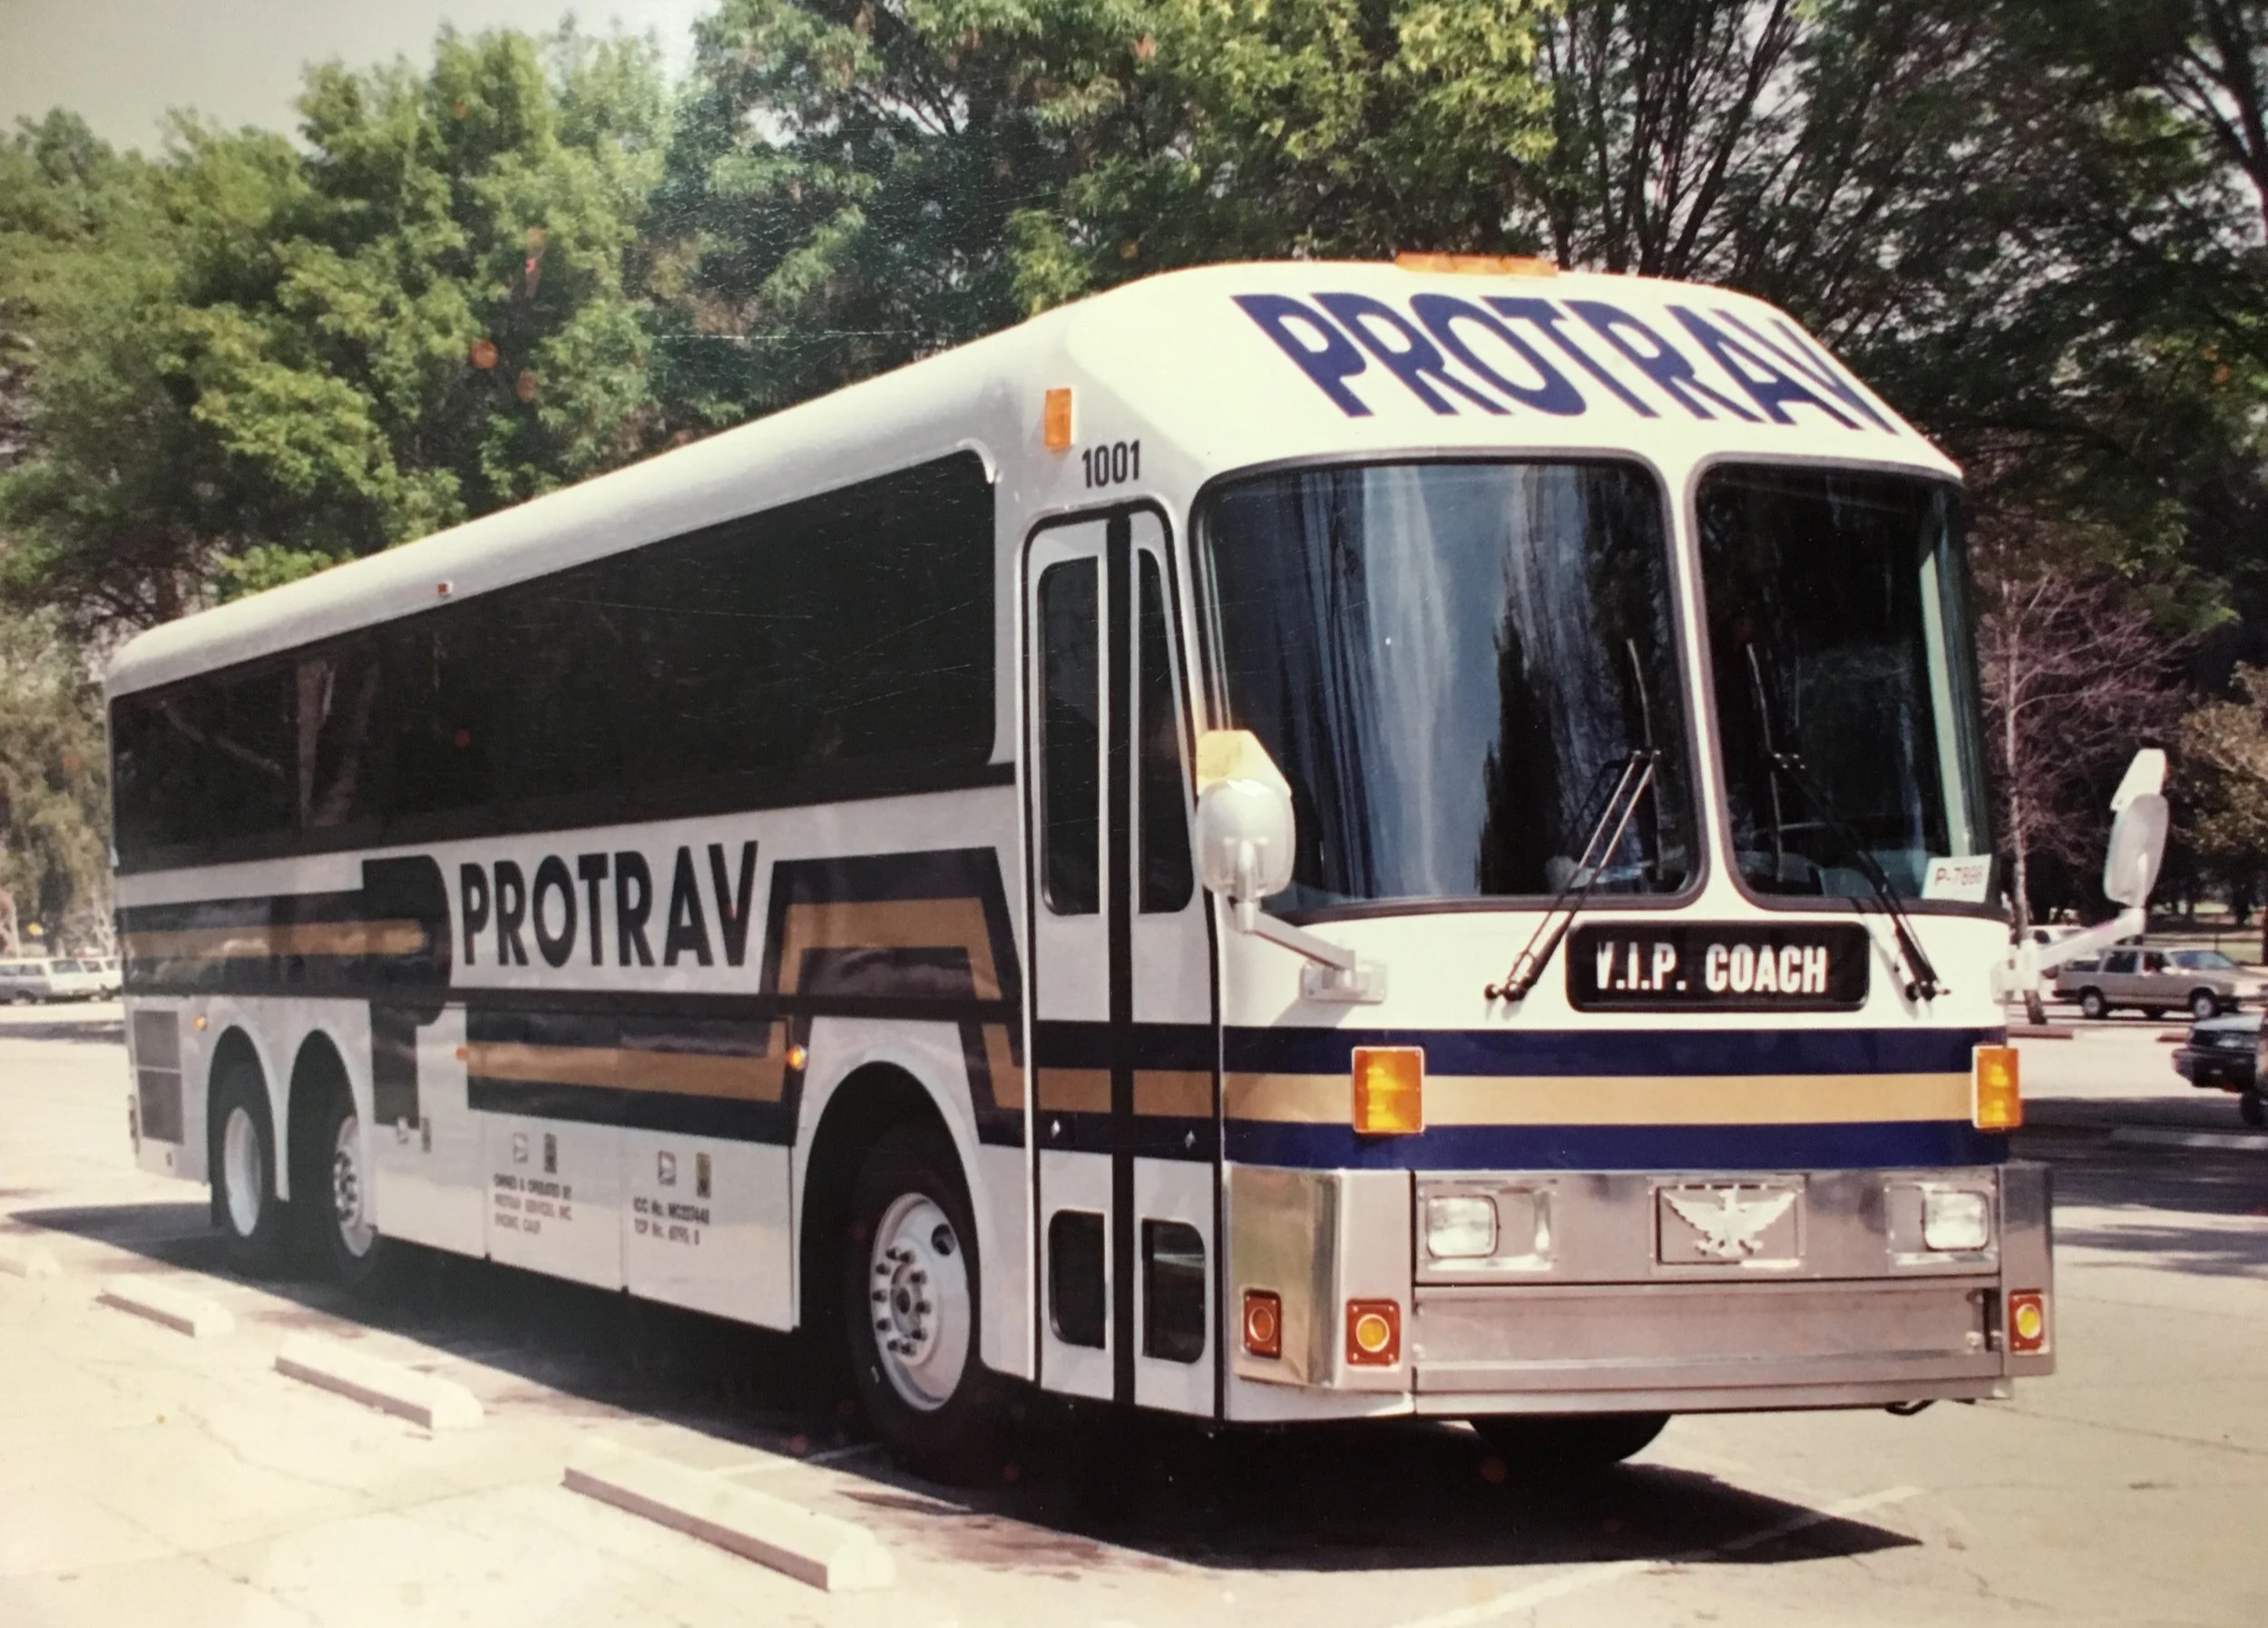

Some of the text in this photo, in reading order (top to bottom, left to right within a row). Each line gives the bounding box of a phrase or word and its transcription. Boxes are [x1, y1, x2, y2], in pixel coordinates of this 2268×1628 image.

[1230, 292, 1901, 435] PROTRAV
[1081, 439, 1139, 489] 1001
[459, 840, 758, 969] PROTRAV
[1596, 941, 1828, 994] V.I.P. COACH
